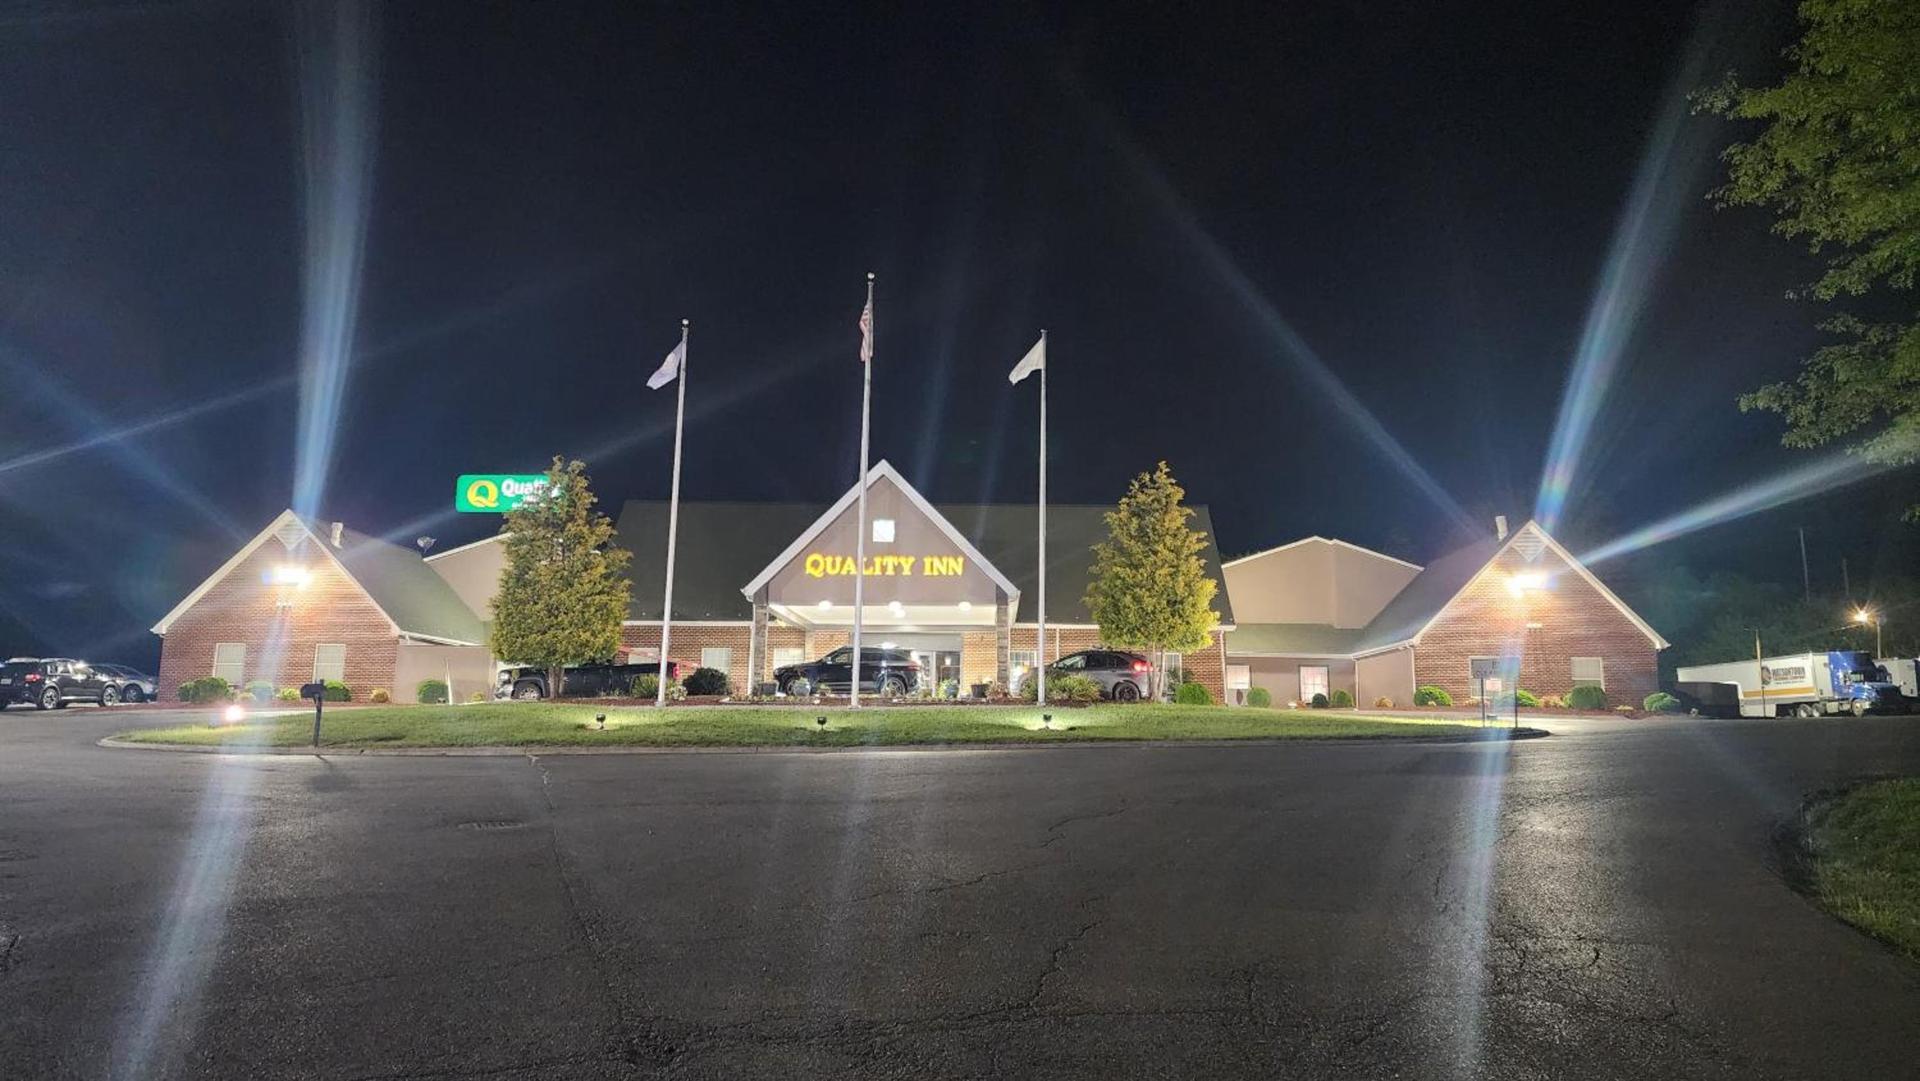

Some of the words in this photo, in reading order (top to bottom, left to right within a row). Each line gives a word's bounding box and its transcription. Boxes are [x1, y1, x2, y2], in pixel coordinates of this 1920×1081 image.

[467, 480, 499, 508] Q
[805, 553, 916, 578] QUALITY
[923, 555, 964, 576] INN
